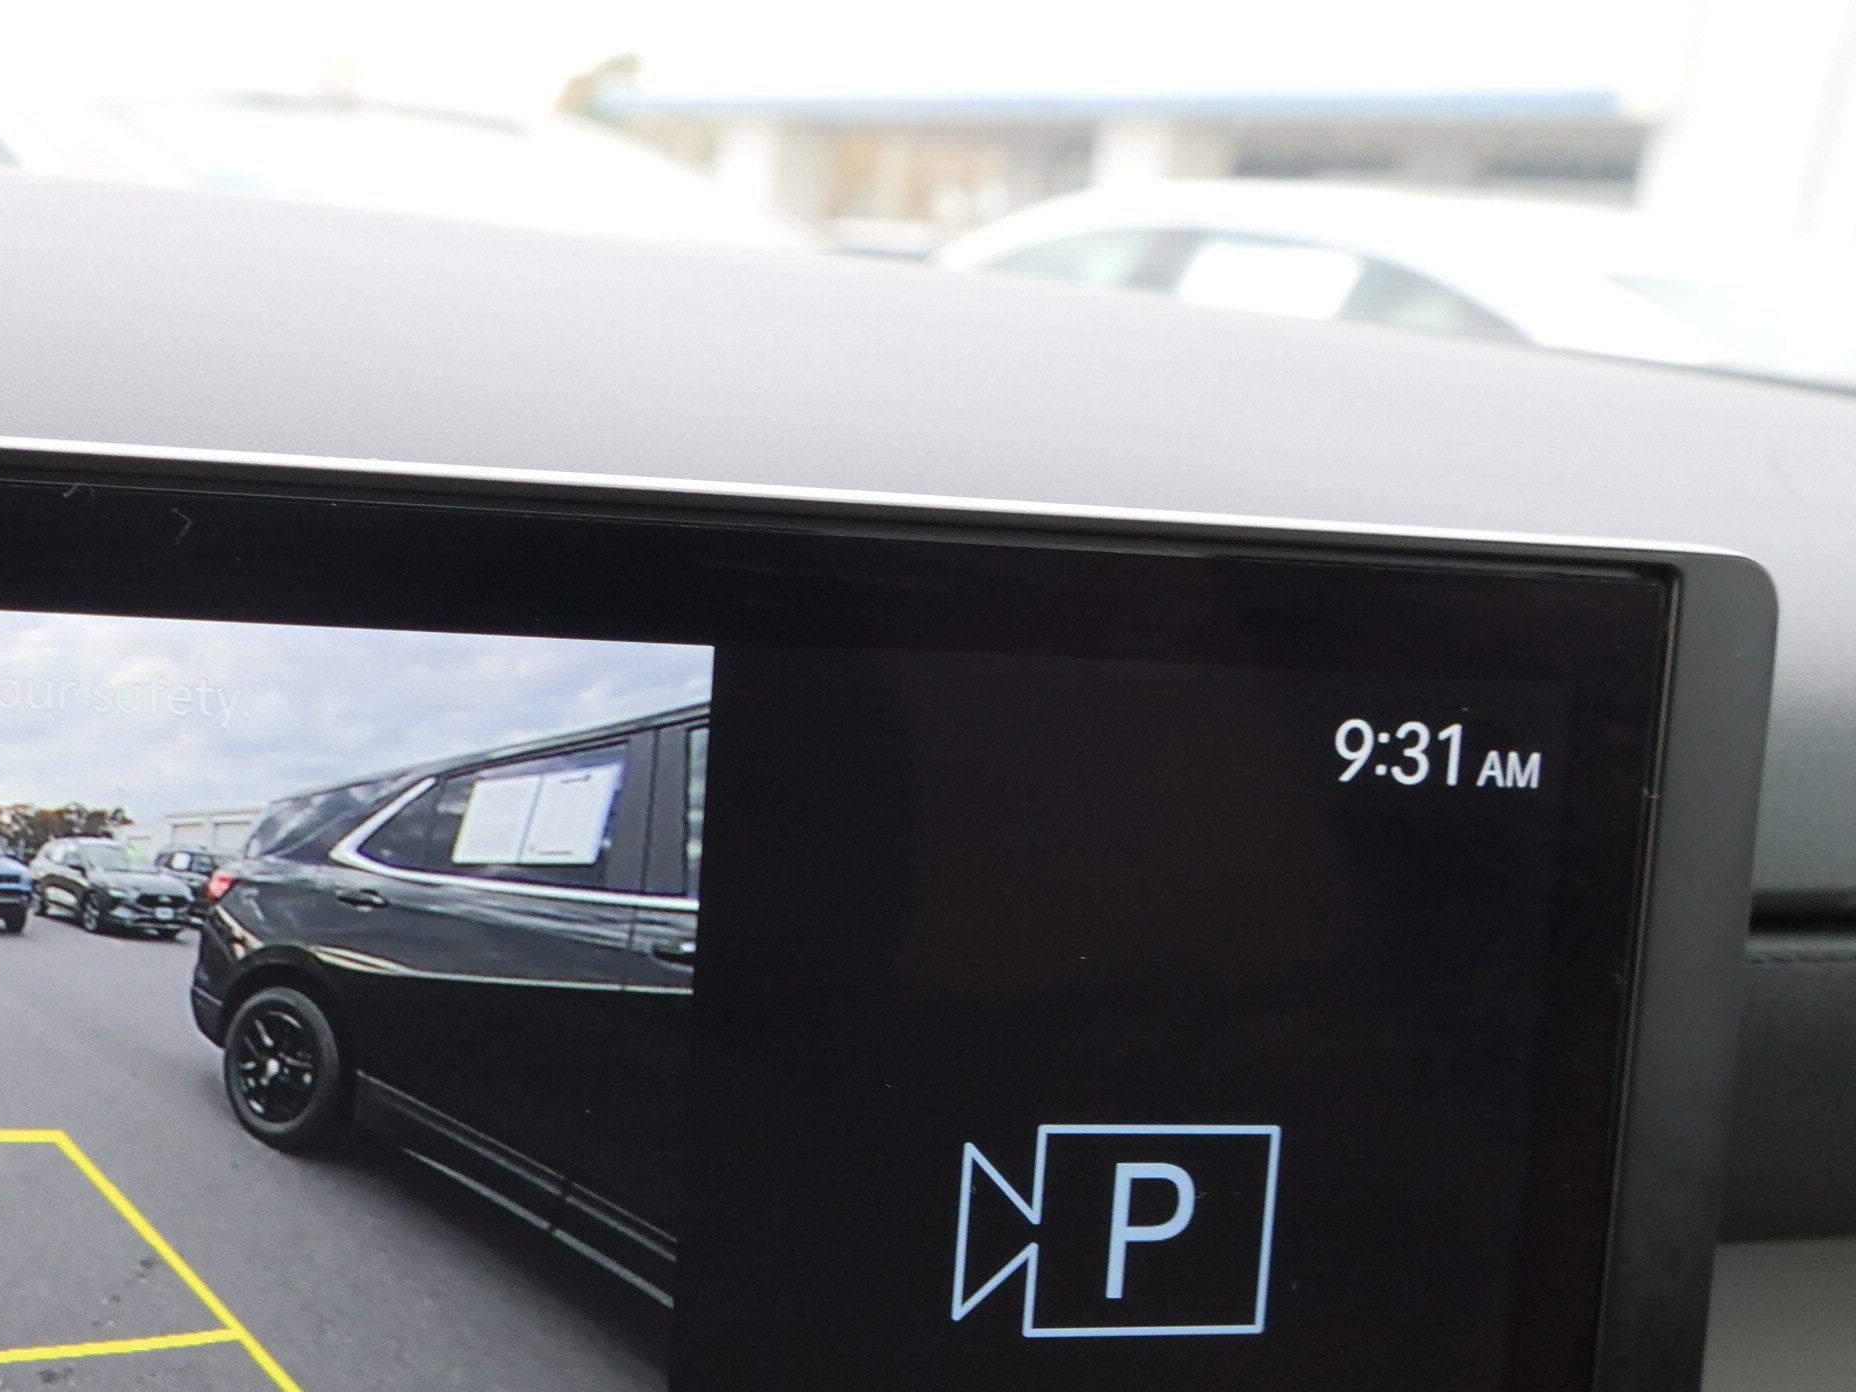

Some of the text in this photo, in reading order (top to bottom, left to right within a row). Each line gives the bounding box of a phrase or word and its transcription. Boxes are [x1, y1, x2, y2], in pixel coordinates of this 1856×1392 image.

[92, 669, 252, 729] safety.
[1334, 718, 1542, 789] 9:31 AM
[1105, 1162, 1195, 1299] P
